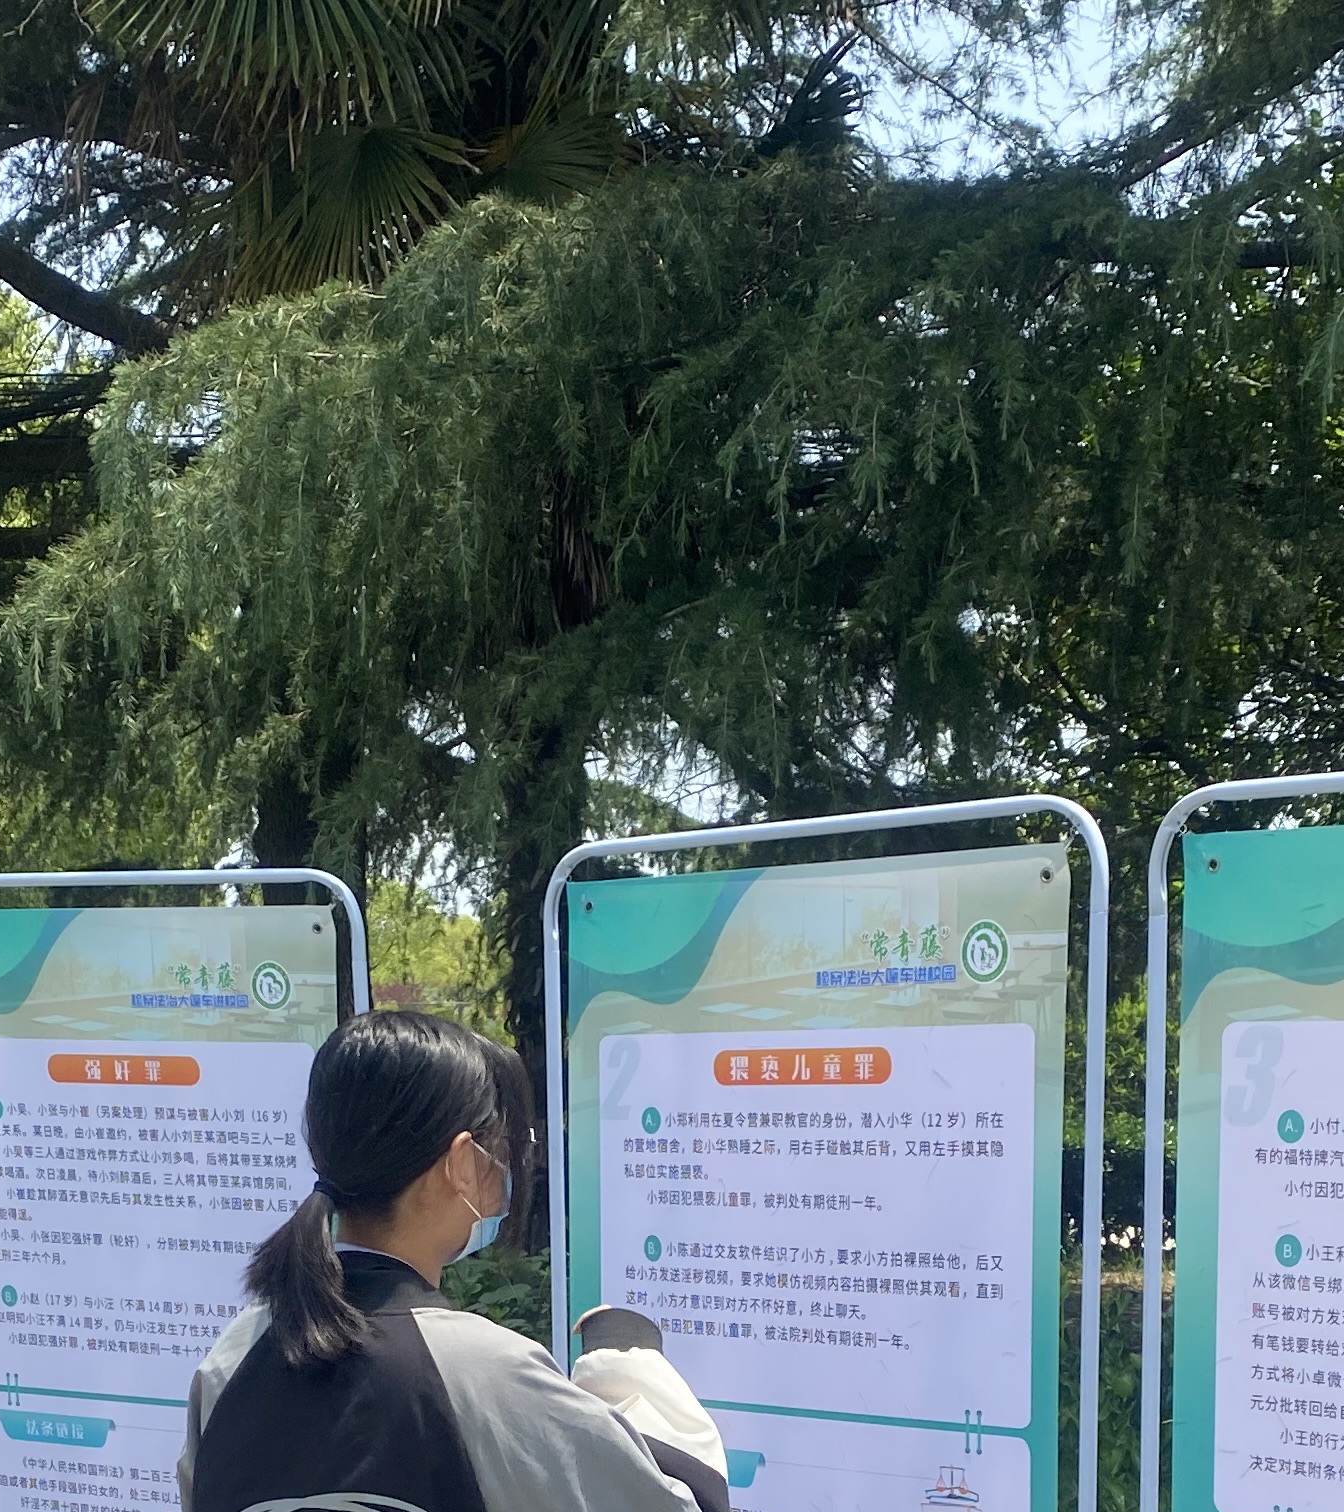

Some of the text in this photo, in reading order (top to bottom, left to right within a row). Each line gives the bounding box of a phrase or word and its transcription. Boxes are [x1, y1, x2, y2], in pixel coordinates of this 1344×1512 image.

[84, 1058, 163, 1082] 强奸罪
[729, 1053, 875, 1082] 猥亵儿童罪
[26, 1419, 84, 1441] 法条链接
